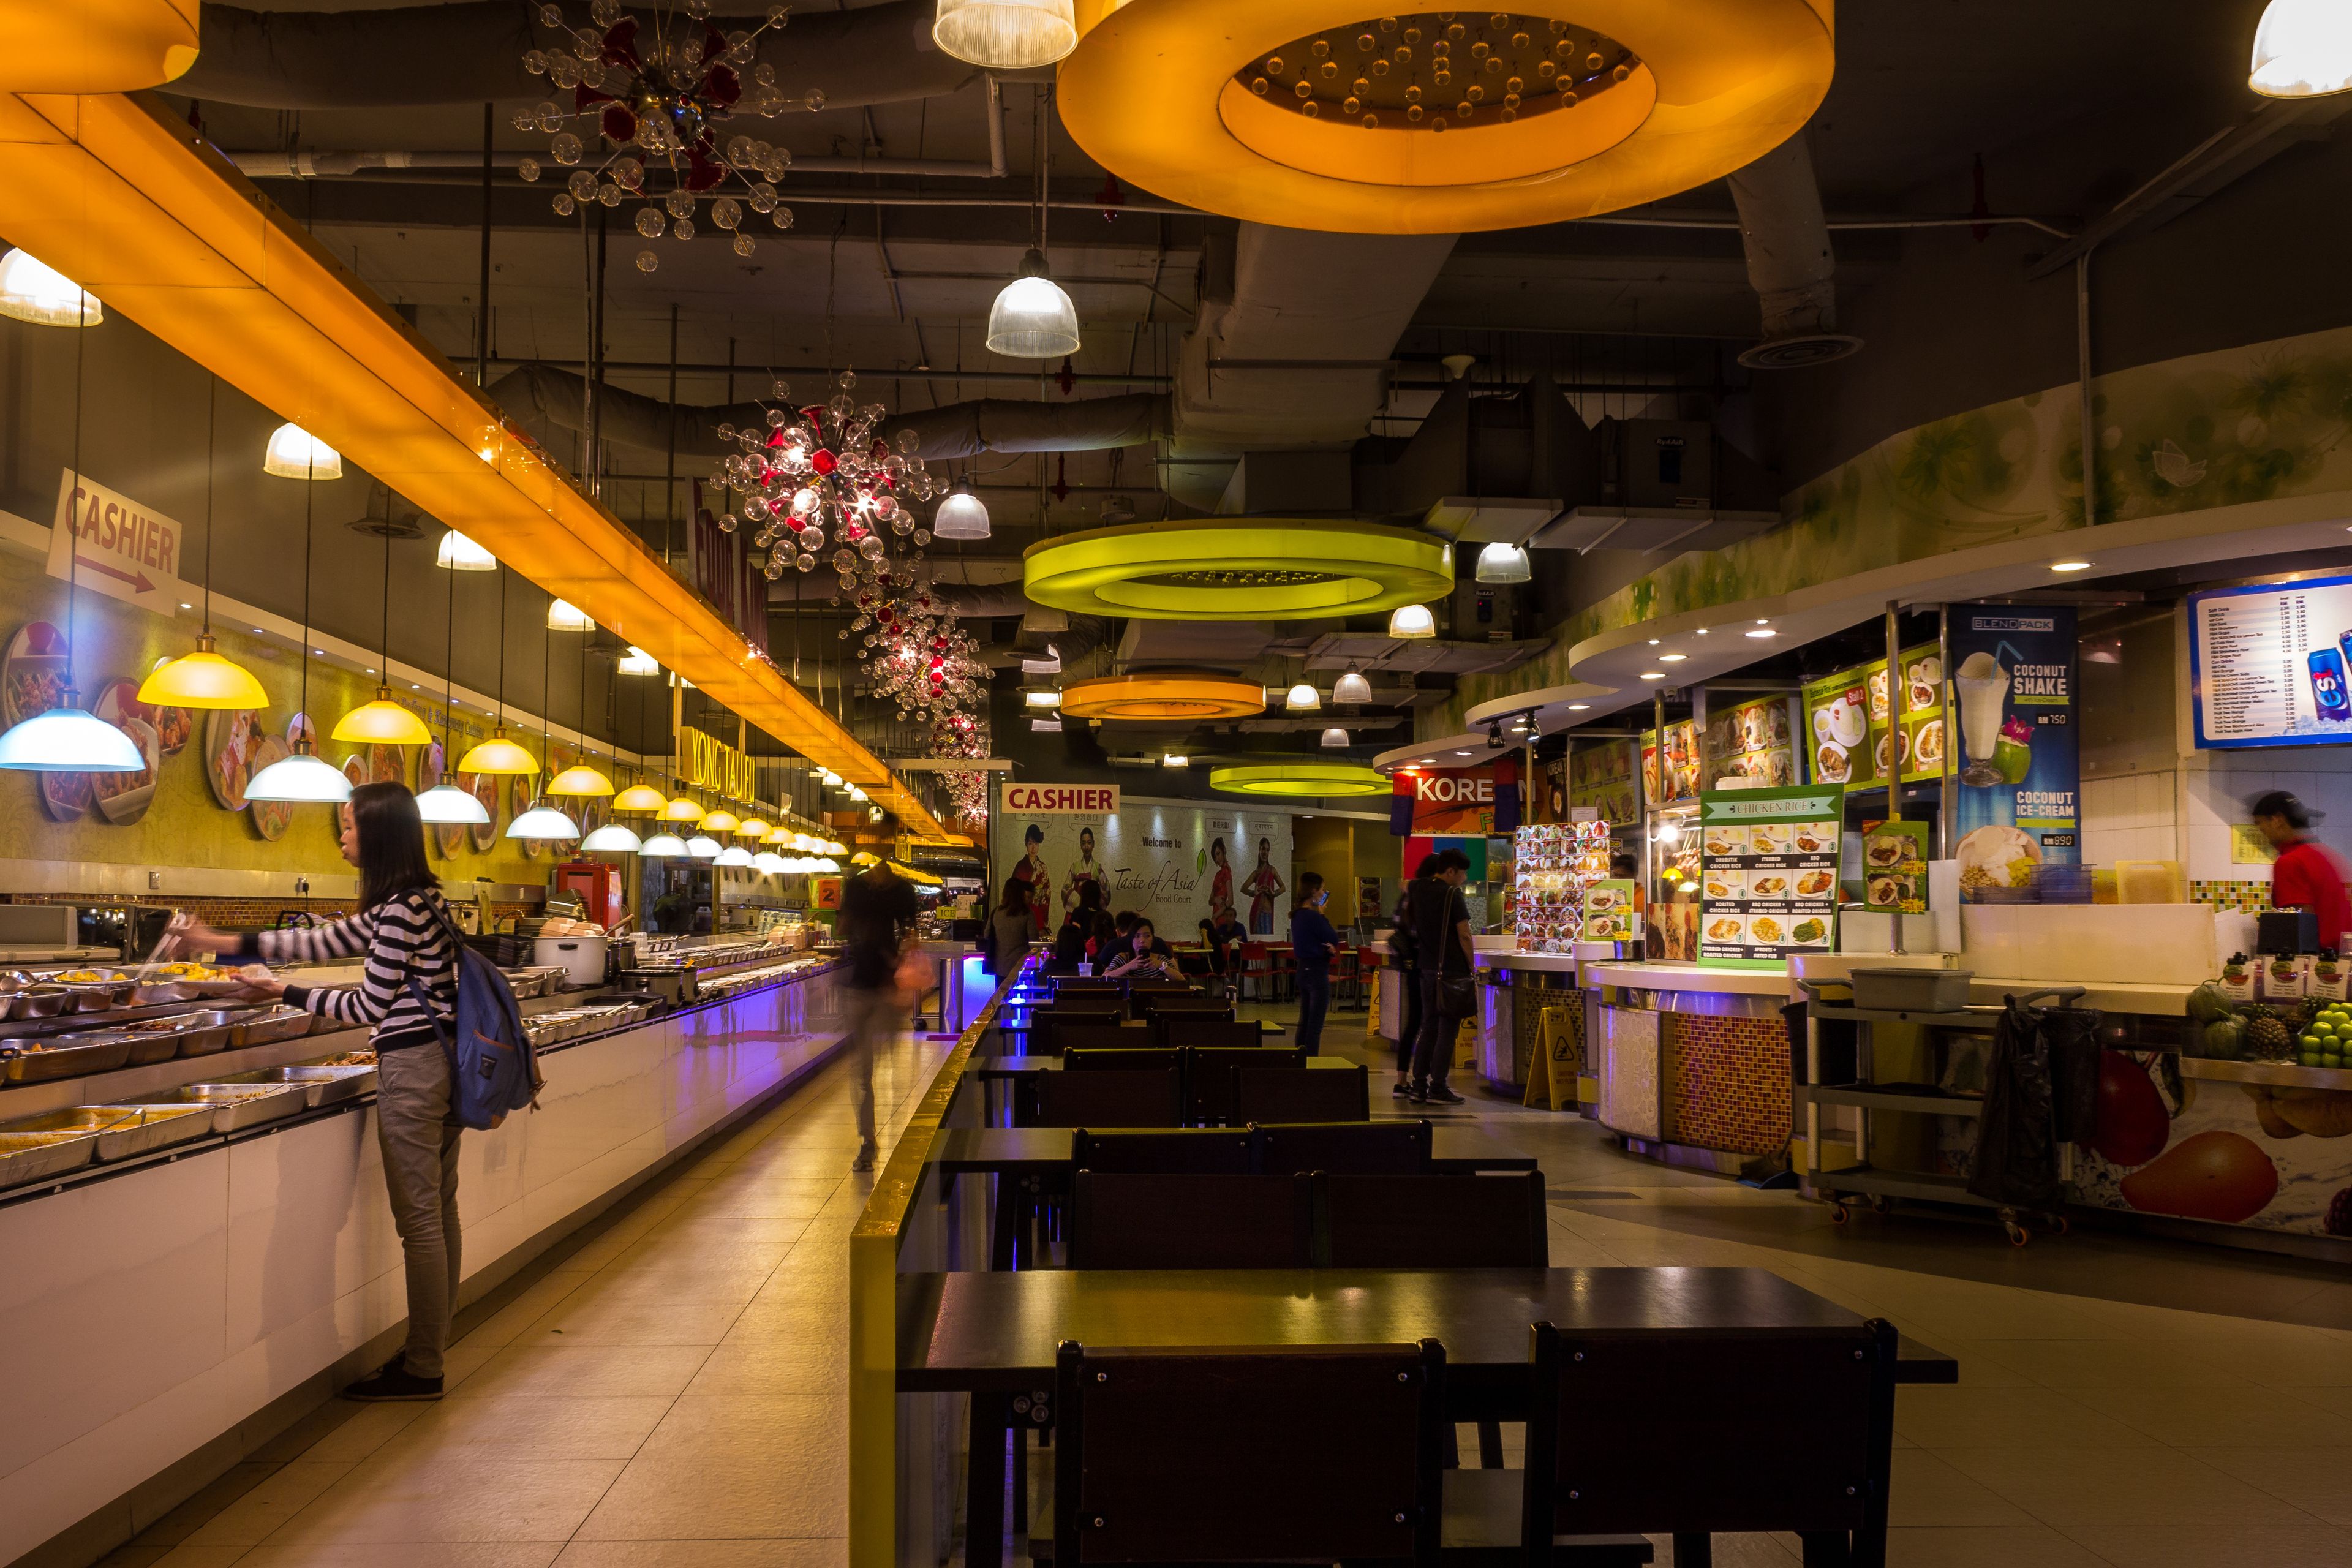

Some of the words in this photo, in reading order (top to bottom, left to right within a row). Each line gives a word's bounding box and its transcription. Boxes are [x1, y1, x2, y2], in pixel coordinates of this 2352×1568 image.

[66, 487, 173, 575] CASHIER
[2013, 665, 2067, 676] COCONUT
[2013, 677, 2067, 695] SHAKE
[2313, 668, 2341, 707] est
[692, 727, 722, 790] YONG
[725, 745, 742, 797] TAU
[745, 755, 755, 802] FU
[1417, 777, 1536, 802] KOREN
[2016, 791, 2074, 804] COCONUT
[1009, 788, 1113, 810] CASHIER
[1738, 802, 1782, 814] CHICKEN
[1785, 801, 1807, 812] RICE
[2016, 805, 2075, 816] ICE-CREAM
[1142, 837, 1172, 848] Welcome
[1175, 839, 1182, 848] to
[1114, 867, 1146, 891] Taste
[1136, 860, 1171, 911] of
[1161, 868, 1197, 892] Asia
[823, 888, 834, 902] 2
[1156, 894, 1171, 903] Food
[1174, 894, 1191, 903] Court
